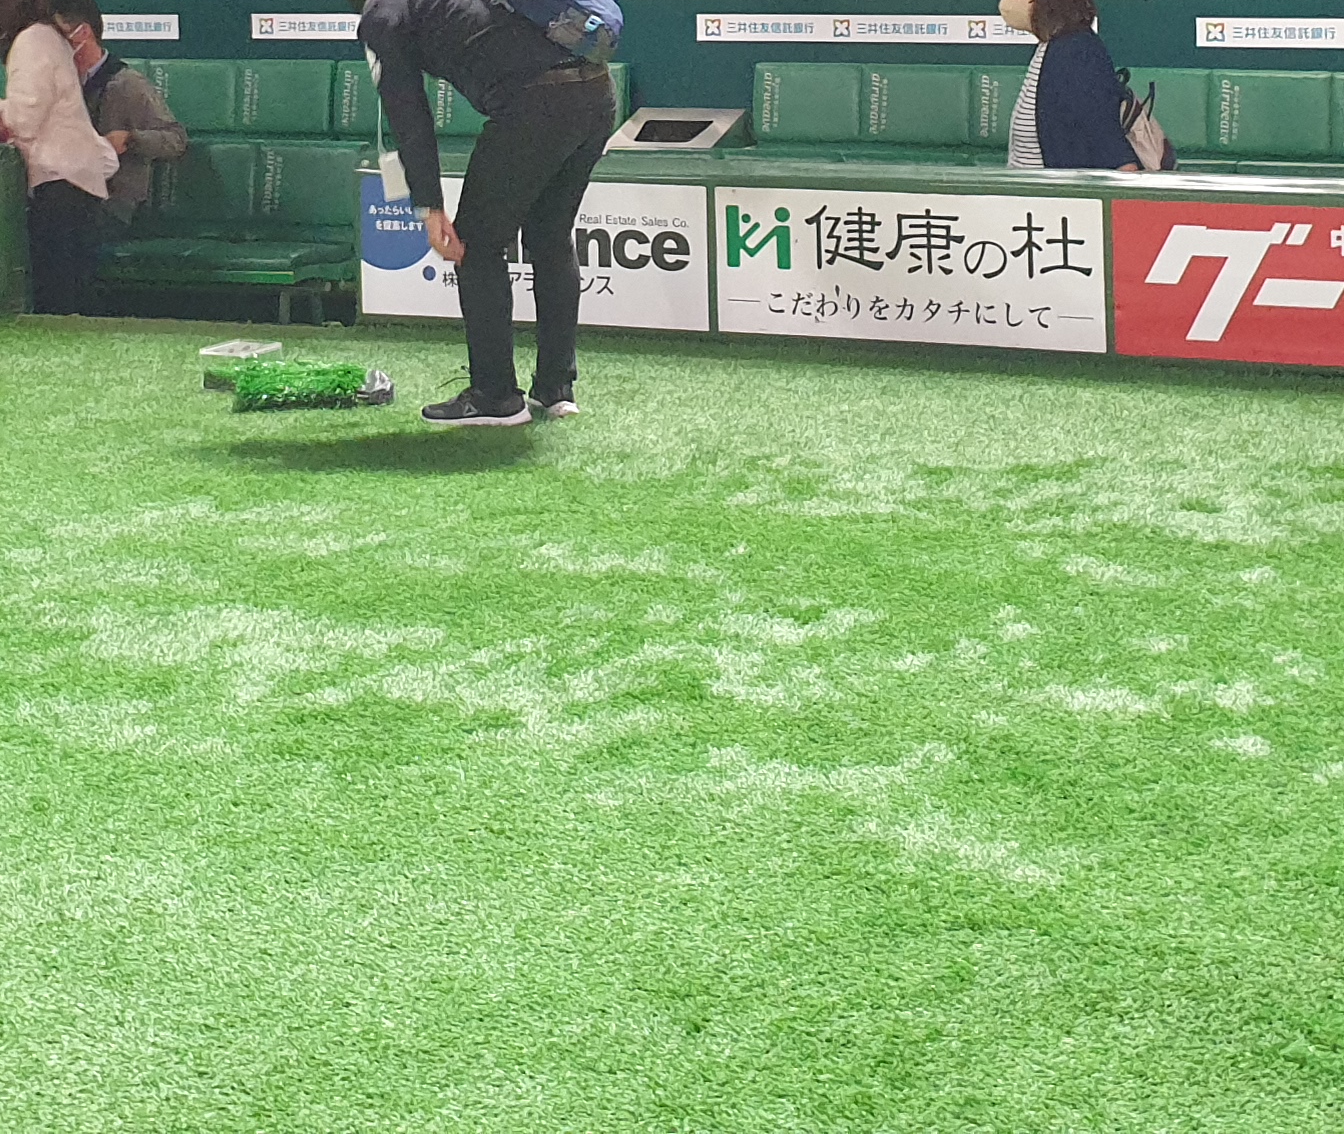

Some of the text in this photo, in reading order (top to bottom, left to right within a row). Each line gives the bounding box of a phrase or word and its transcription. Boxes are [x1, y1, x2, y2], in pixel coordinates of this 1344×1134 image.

[1231, 26, 1337, 40] 三井住友信託銀行
[762, 72, 772, 133] airweave
[868, 72, 880, 135] airweave
[979, 74, 990, 138] airweave
[1219, 79, 1231, 145] airweave
[579, 213, 690, 228] Real Estate Sales Co.
[804, 204, 1093, 279] 健康の杜
[767, 291, 1052, 329] こだわりをカタチにして
